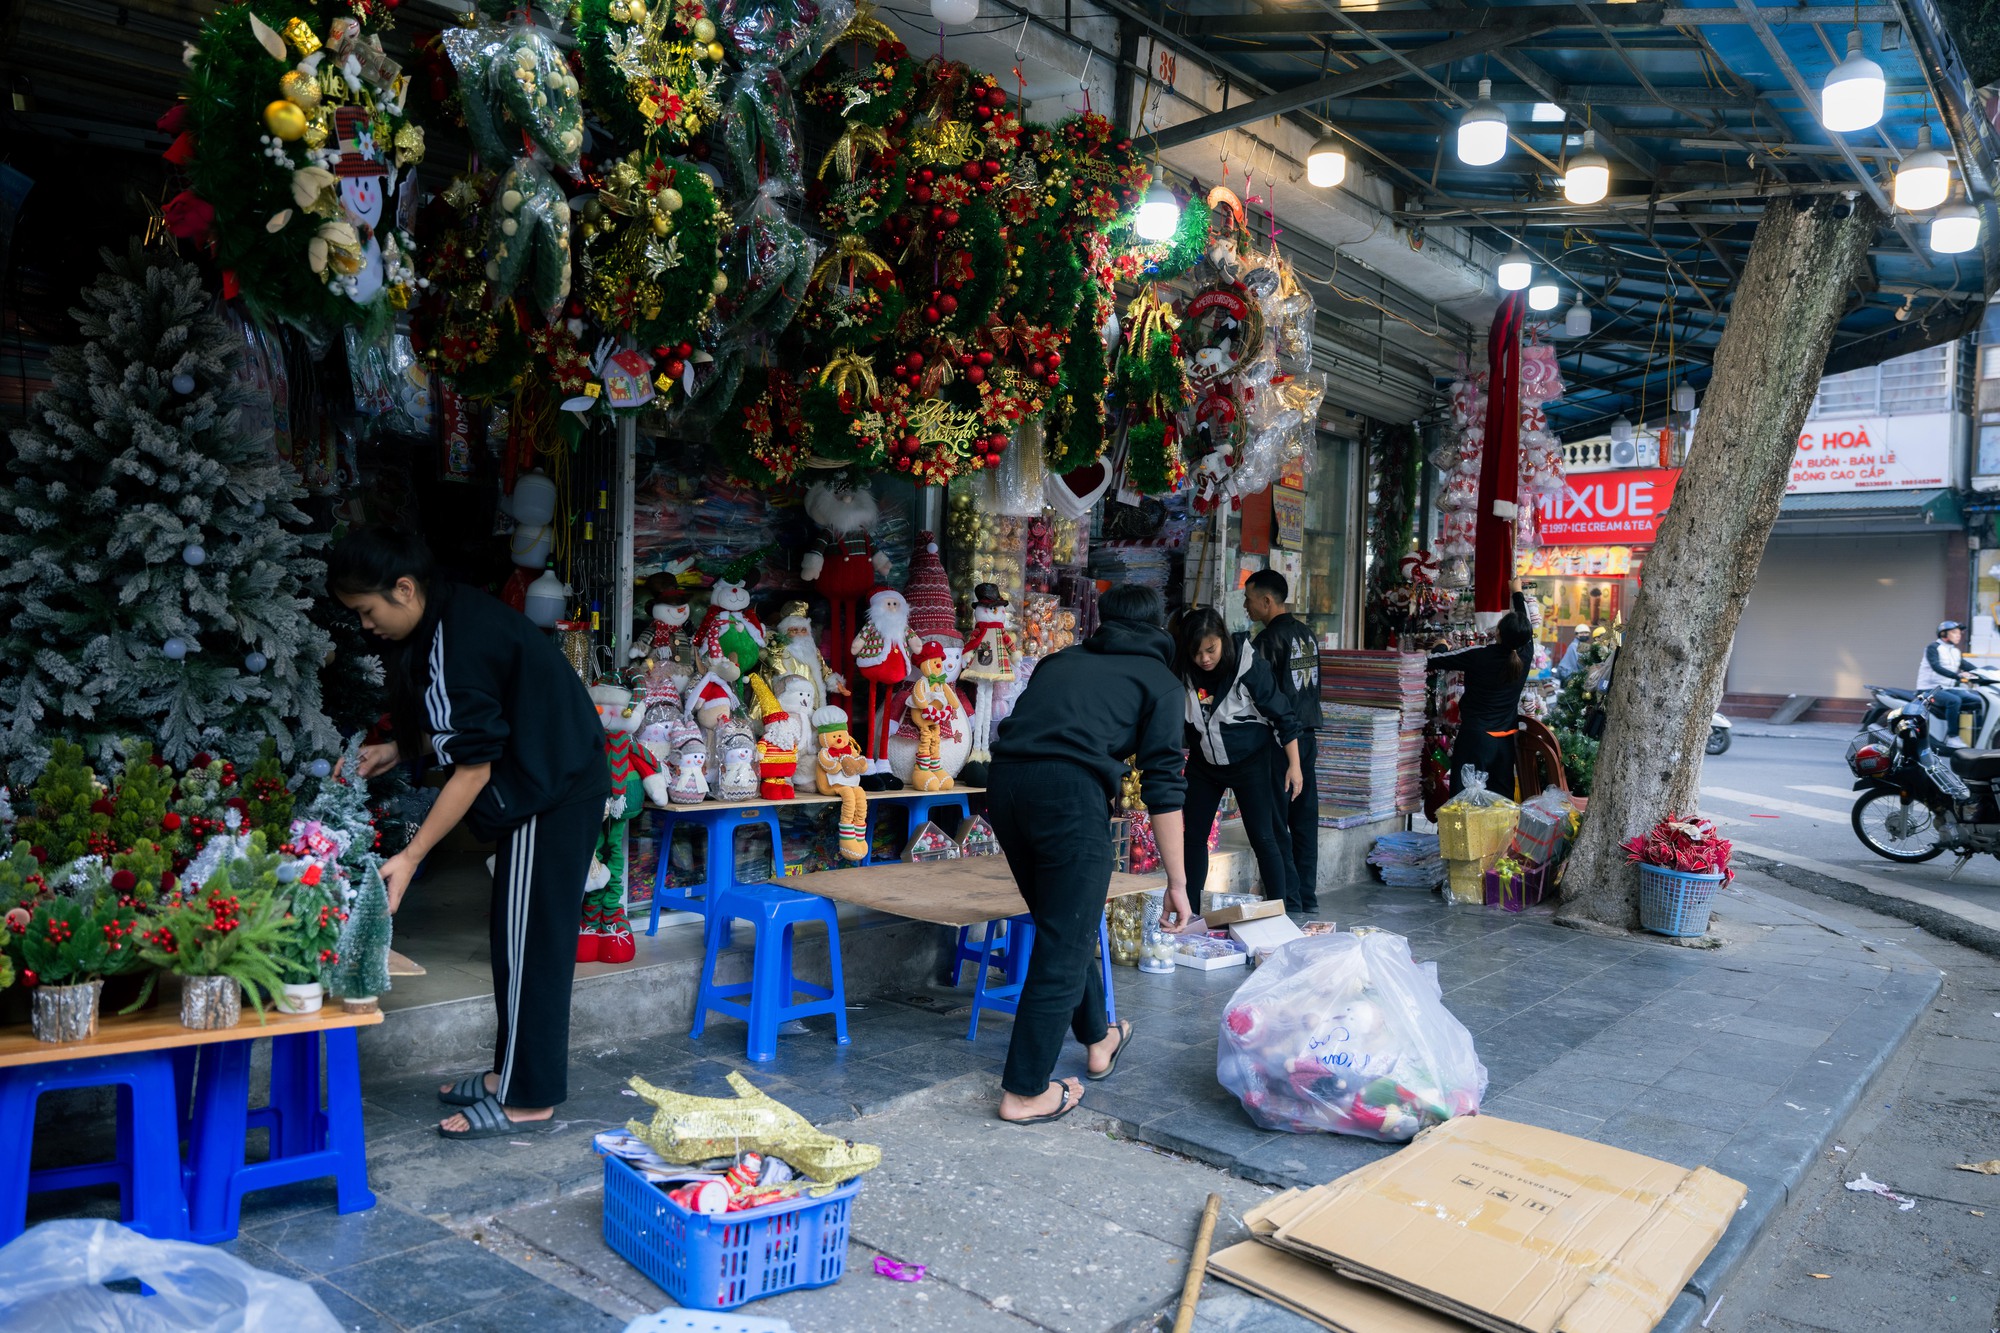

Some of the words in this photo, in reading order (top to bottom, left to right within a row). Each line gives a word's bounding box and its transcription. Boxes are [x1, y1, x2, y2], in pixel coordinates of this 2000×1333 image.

[1159, 51, 1177, 86] 39
[1822, 424, 1871, 450] HOÀ
[1807, 455, 1840, 468] BUÔN
[1849, 453, 1875, 466] BÁN
[1829, 470, 1856, 480] CAO
[1588, 521, 1623, 532] CREAM
[1623, 521, 1631, 531] &
[1631, 520, 1653, 531] TEA
